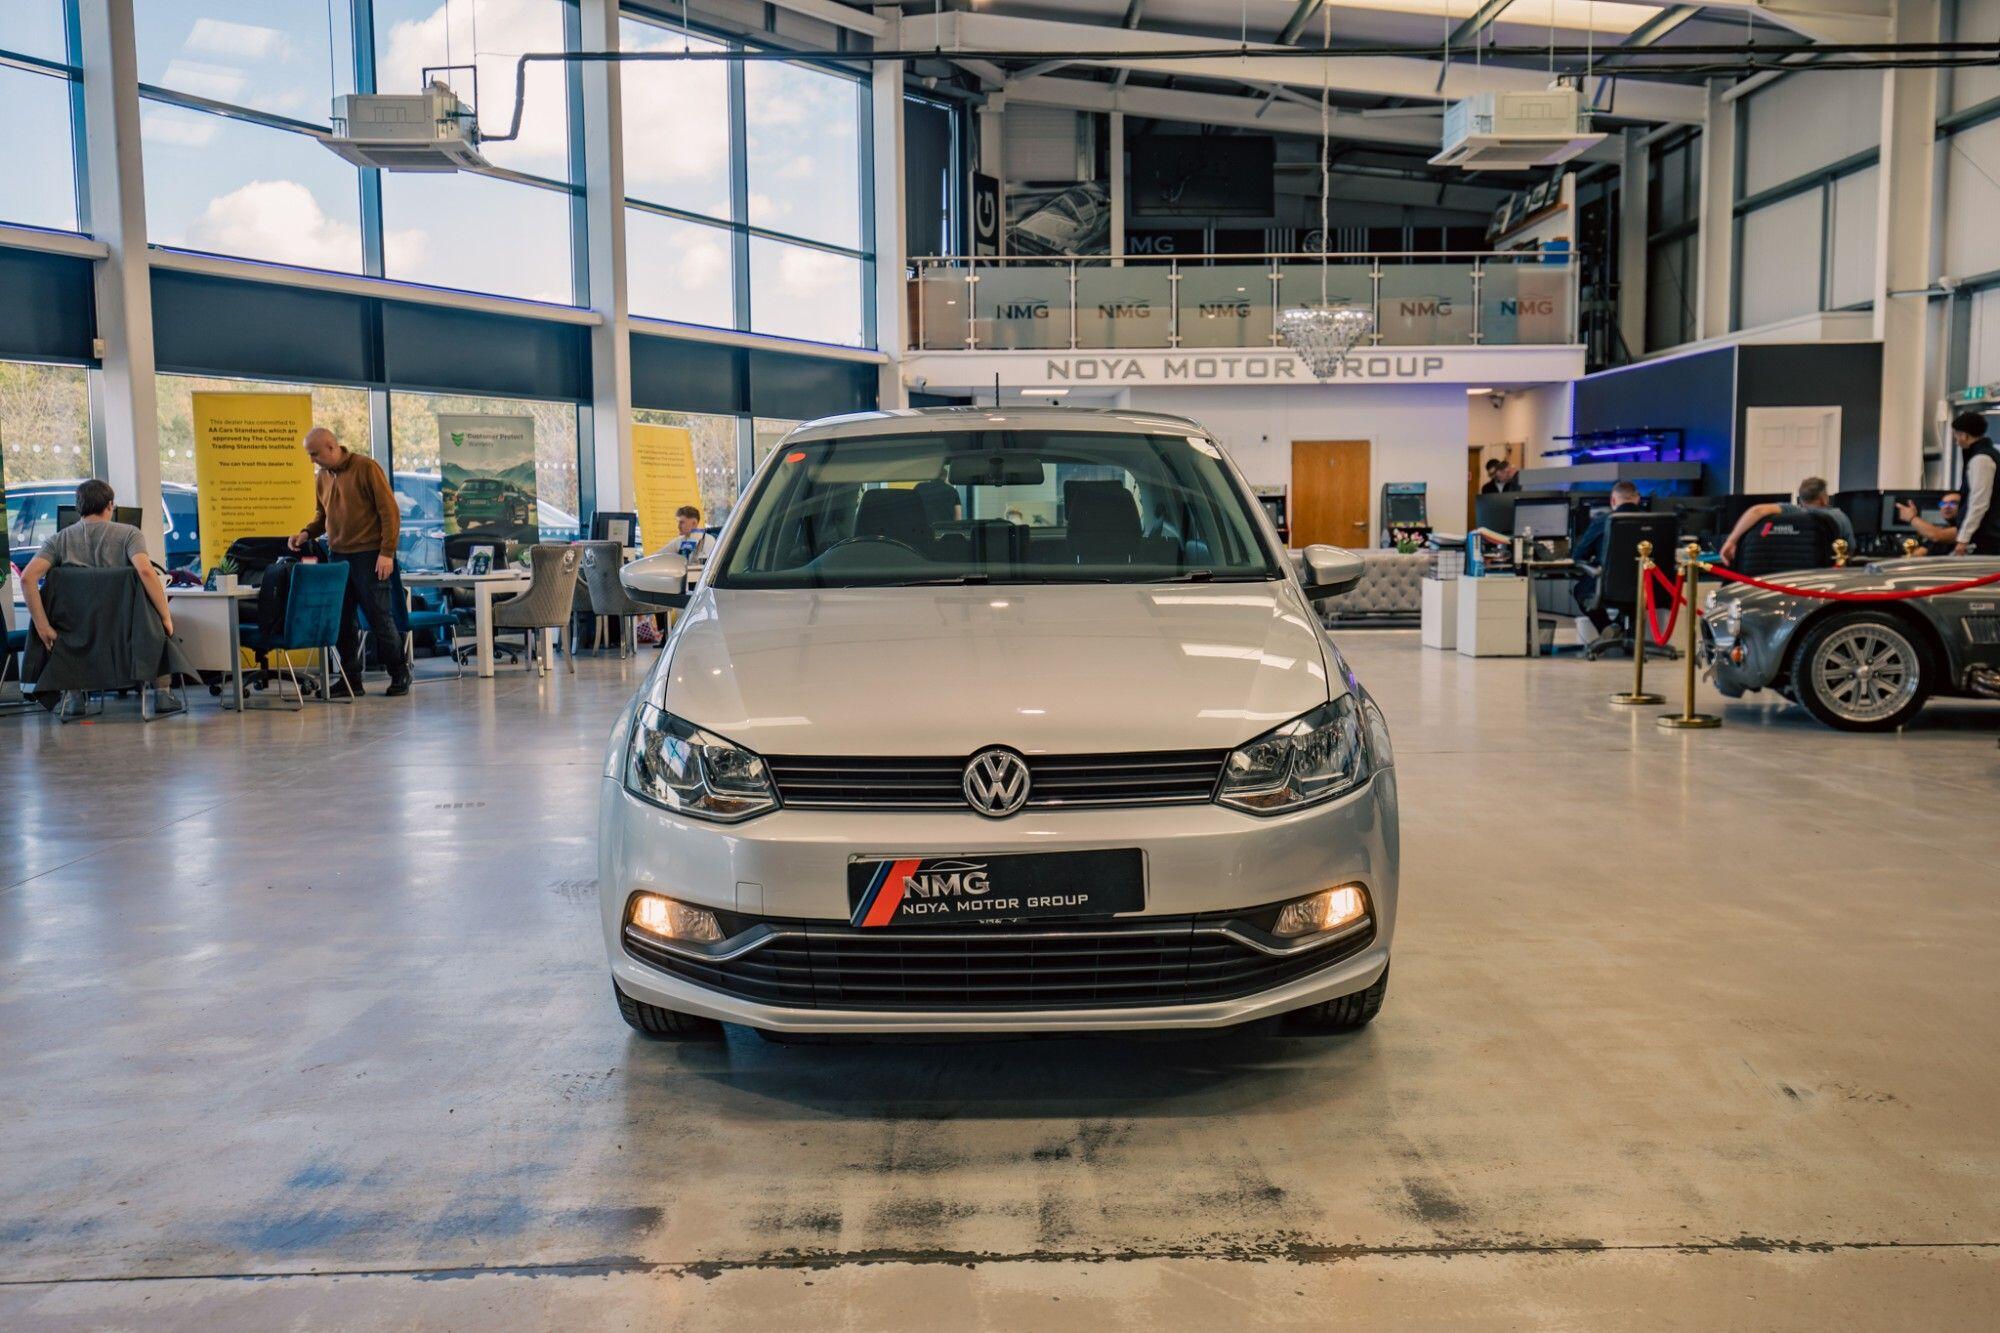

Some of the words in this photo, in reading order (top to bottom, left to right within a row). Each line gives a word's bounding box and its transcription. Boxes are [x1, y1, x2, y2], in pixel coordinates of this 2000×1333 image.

[1125, 236, 1174, 253] MG
[997, 304, 1049, 319] NMG
[1099, 303, 1150, 319] NMG
[1199, 303, 1251, 318] NMG
[1400, 301, 1452, 316] NMG
[1501, 300, 1553, 315] NMG
[1047, 358, 1146, 379] NOYA
[1164, 358, 1295, 379] MOTOR
[1317, 356, 1444, 378] ROUP
[968, 752, 1027, 812] VW
[903, 872, 990, 898] NMG
[903, 902, 949, 915] NOYA
[957, 898, 1019, 912] MOTOR
[1027, 894, 1089, 908] GROUP
